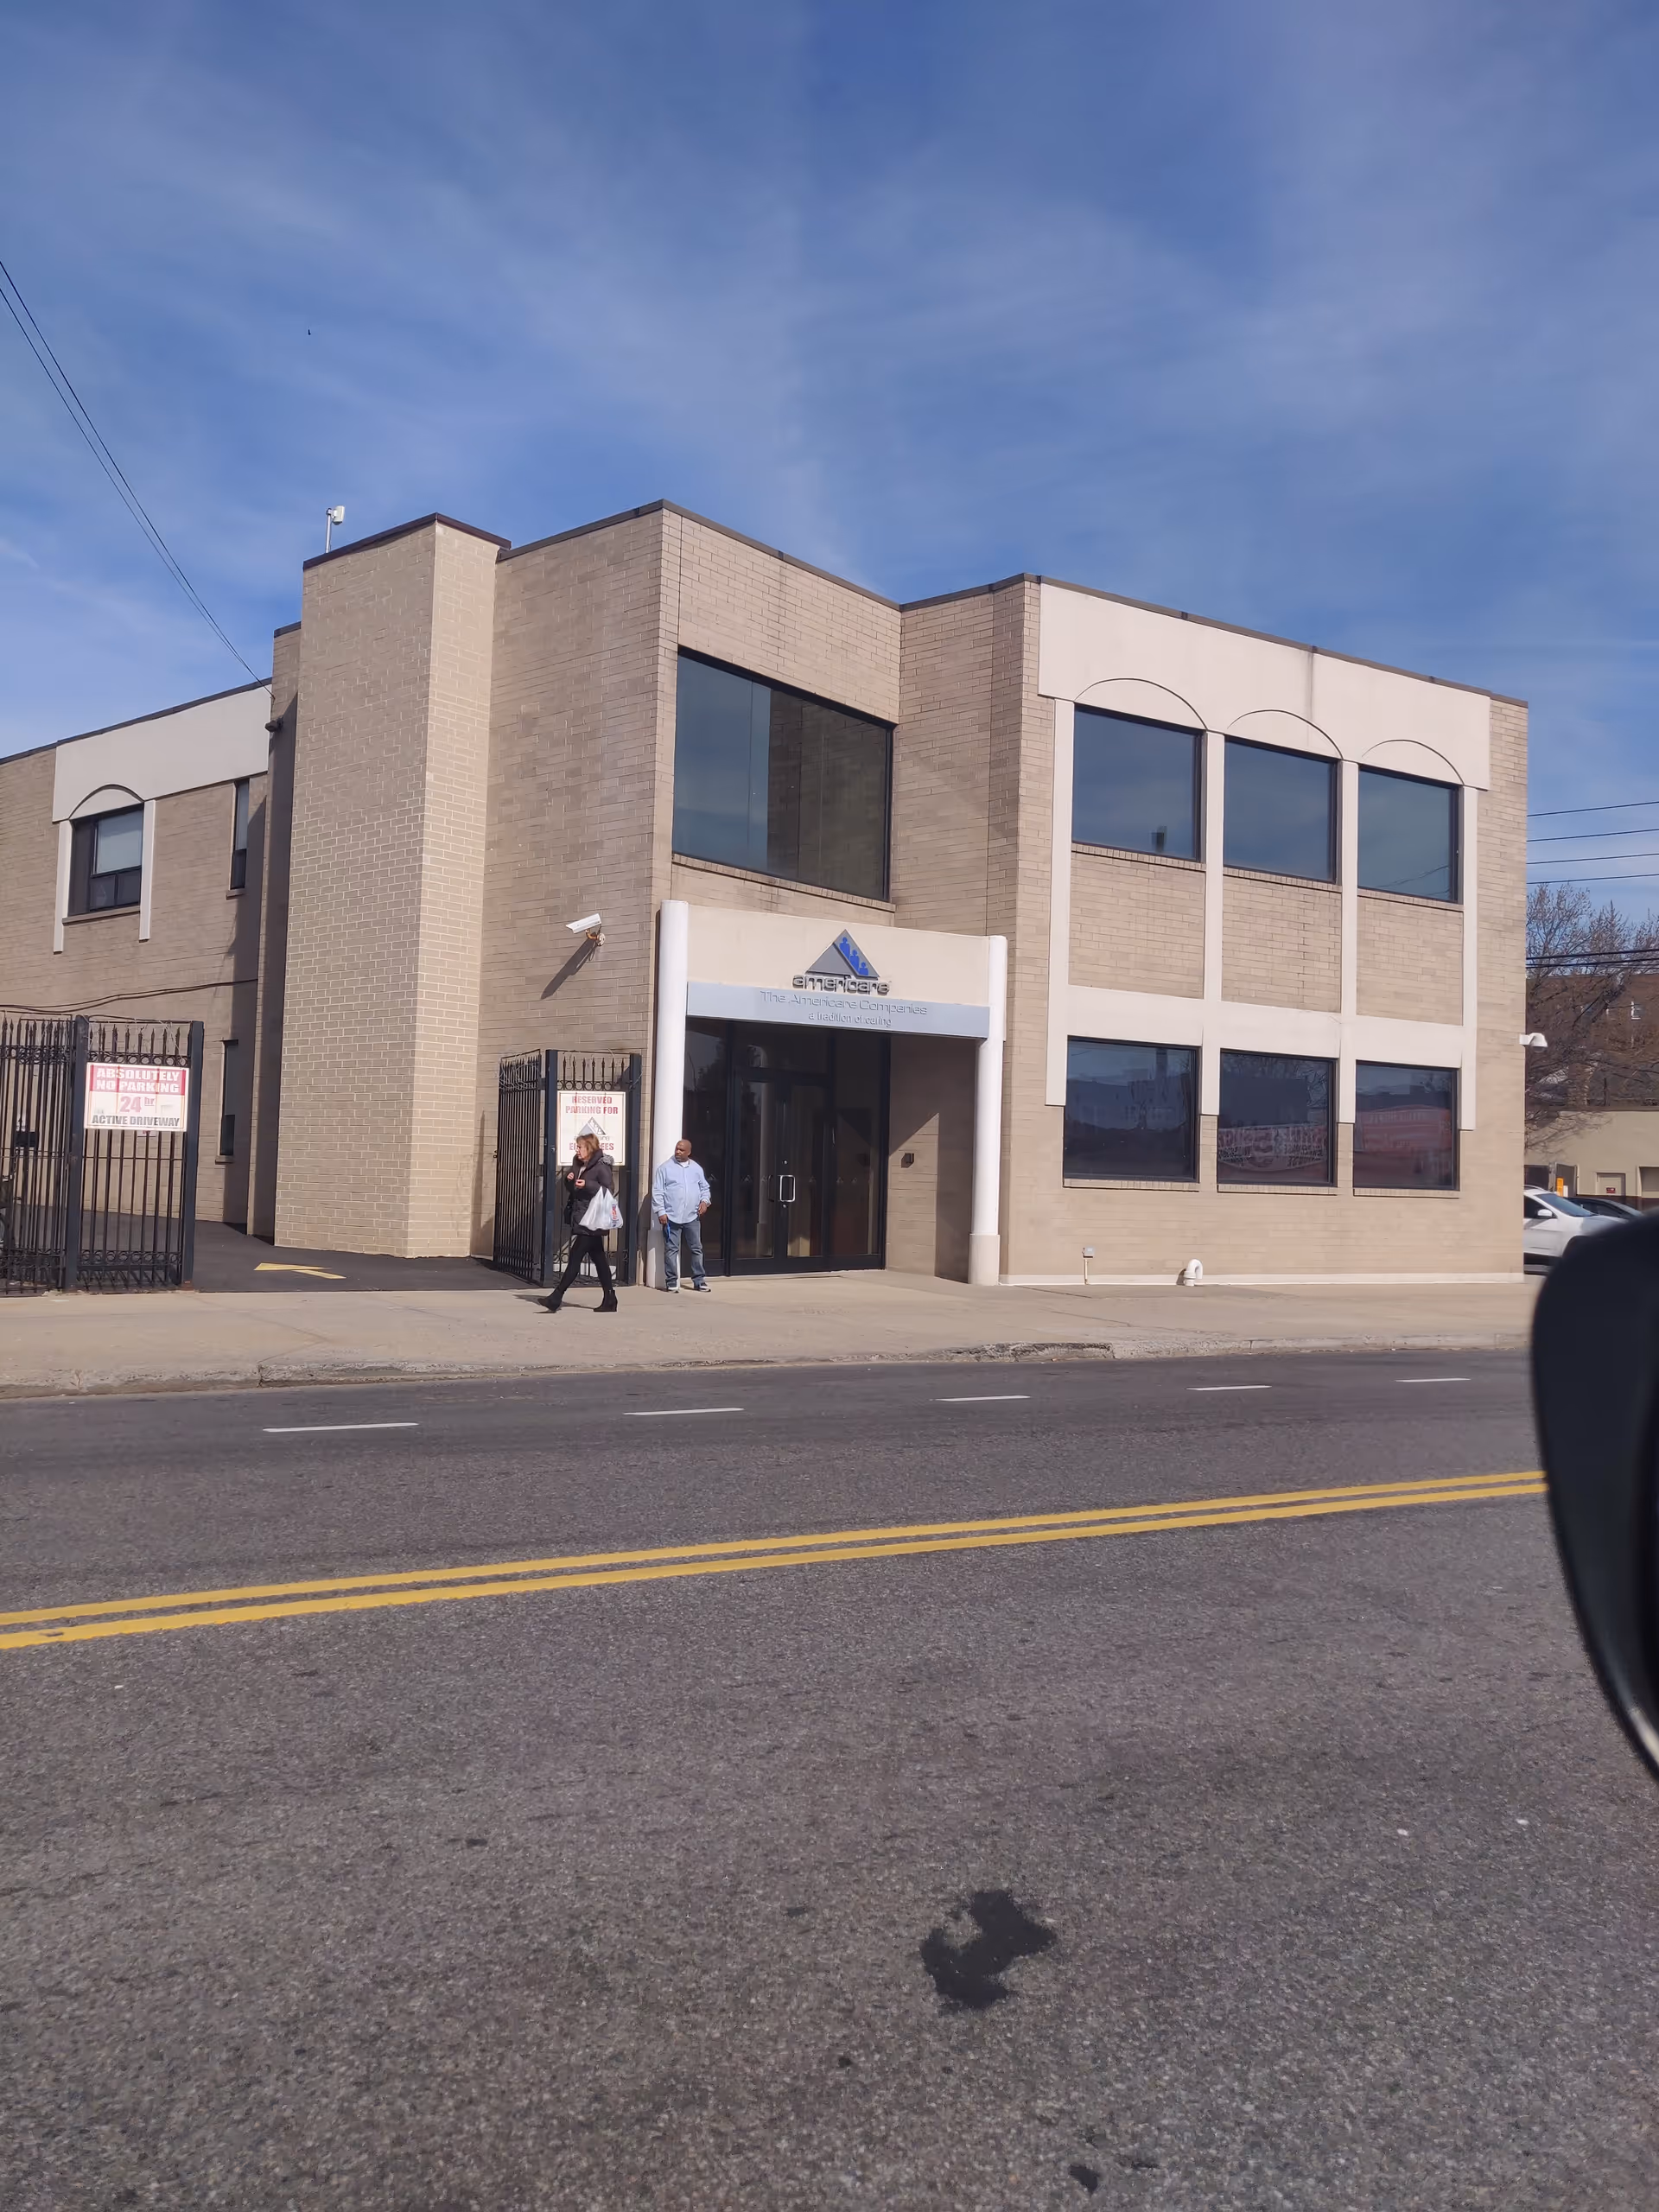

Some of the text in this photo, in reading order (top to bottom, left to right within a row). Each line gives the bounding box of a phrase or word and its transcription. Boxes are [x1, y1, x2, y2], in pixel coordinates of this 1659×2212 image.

[792, 974, 890, 995] americare
[760, 991, 928, 1015] The Americare Companies
[817, 1012, 851, 1023] tradition
[865, 1017, 892, 1027] caring
[96, 1068, 180, 1082] ABSOLUTELY
[96, 1080, 180, 1093] NO PARKING
[119, 1096, 155, 1113] 24 hr
[571, 1096, 613, 1104] RESERVED
[565, 1105, 601, 1114] PARKING
[92, 1115, 180, 1127] ACTIVE DRIVEWAY
